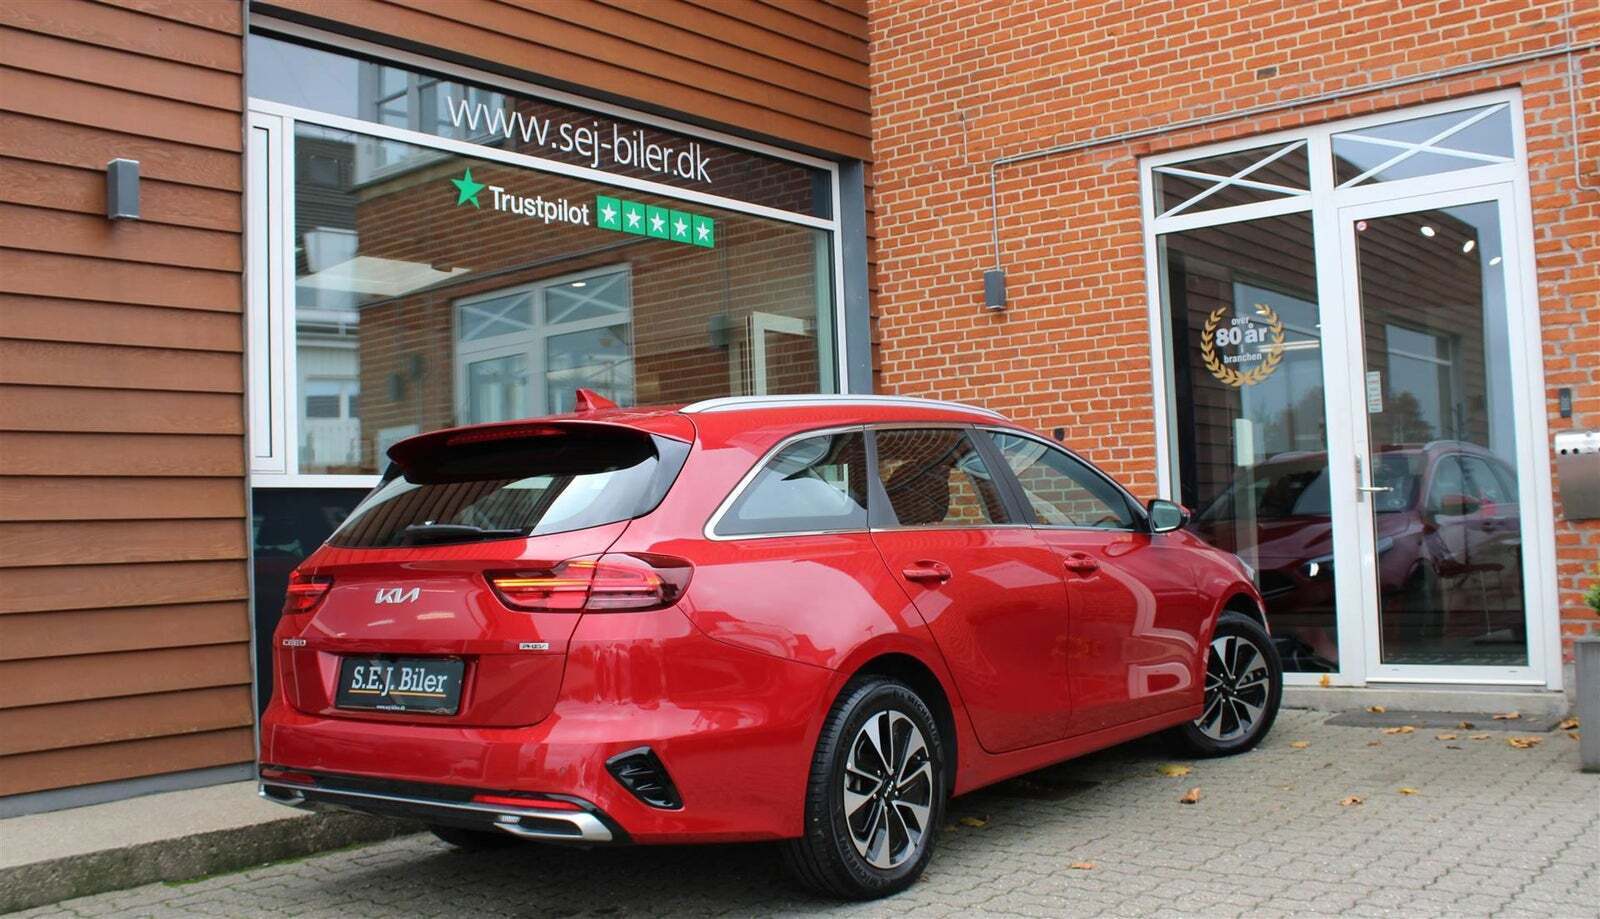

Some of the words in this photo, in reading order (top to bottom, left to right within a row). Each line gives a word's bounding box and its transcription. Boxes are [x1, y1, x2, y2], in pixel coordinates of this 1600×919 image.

[447, 95, 712, 184] www.sej-biler.dk
[488, 185, 590, 225] Trustpilot
[1231, 316, 1250, 326] over
[1215, 326, 1242, 347] 80
[1244, 323, 1268, 344] år
[1223, 352, 1262, 364] branchen
[375, 587, 420, 604] KIA
[351, 665, 395, 697] S.E.J.
[398, 667, 448, 693] Biler
